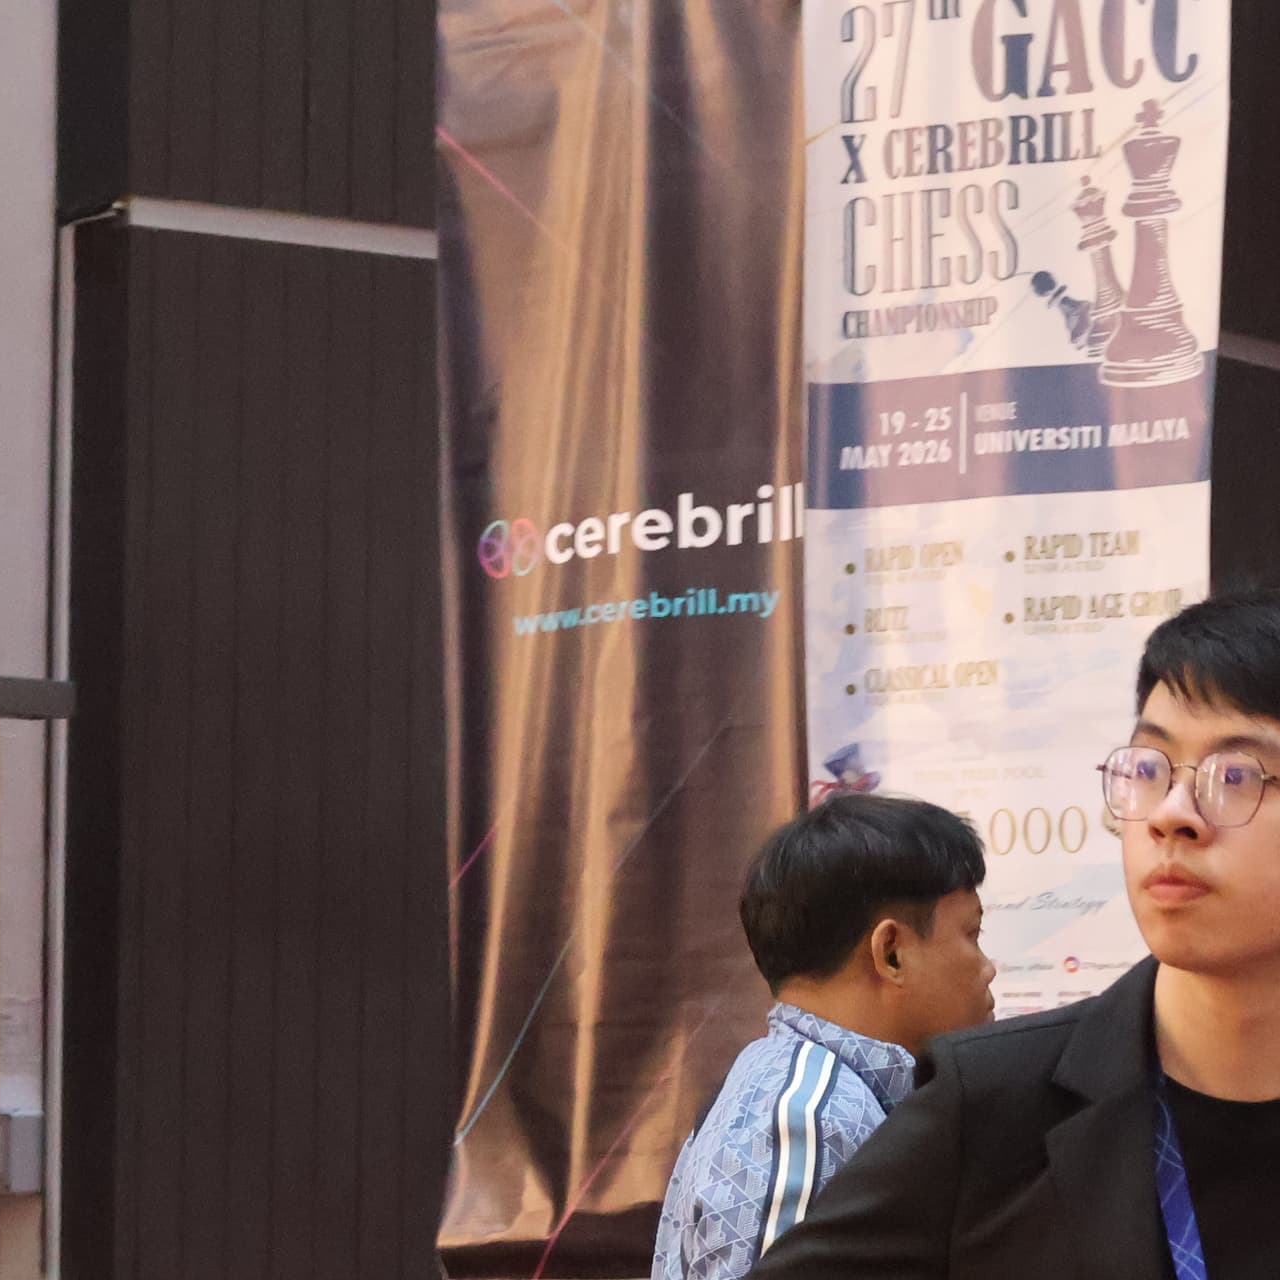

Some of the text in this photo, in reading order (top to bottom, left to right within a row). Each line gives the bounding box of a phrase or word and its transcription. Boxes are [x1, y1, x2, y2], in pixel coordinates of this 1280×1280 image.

[971, 0, 1199, 102] GACC
[883, 108, 1102, 180] CEREBRILL
[843, 180, 1020, 297] CHESS
[880, 411, 905, 436] 19
[924, 407, 953, 433] 25
[974, 417, 1190, 455] UNIVERSITI MALAYA
[840, 439, 953, 470] MAY 2026
[545, 482, 804, 565] cerebrill
[1023, 535, 1083, 560] RAPID
[513, 588, 781, 635] www.cerebrill.my
[1023, 596, 1082, 622] RAPID
